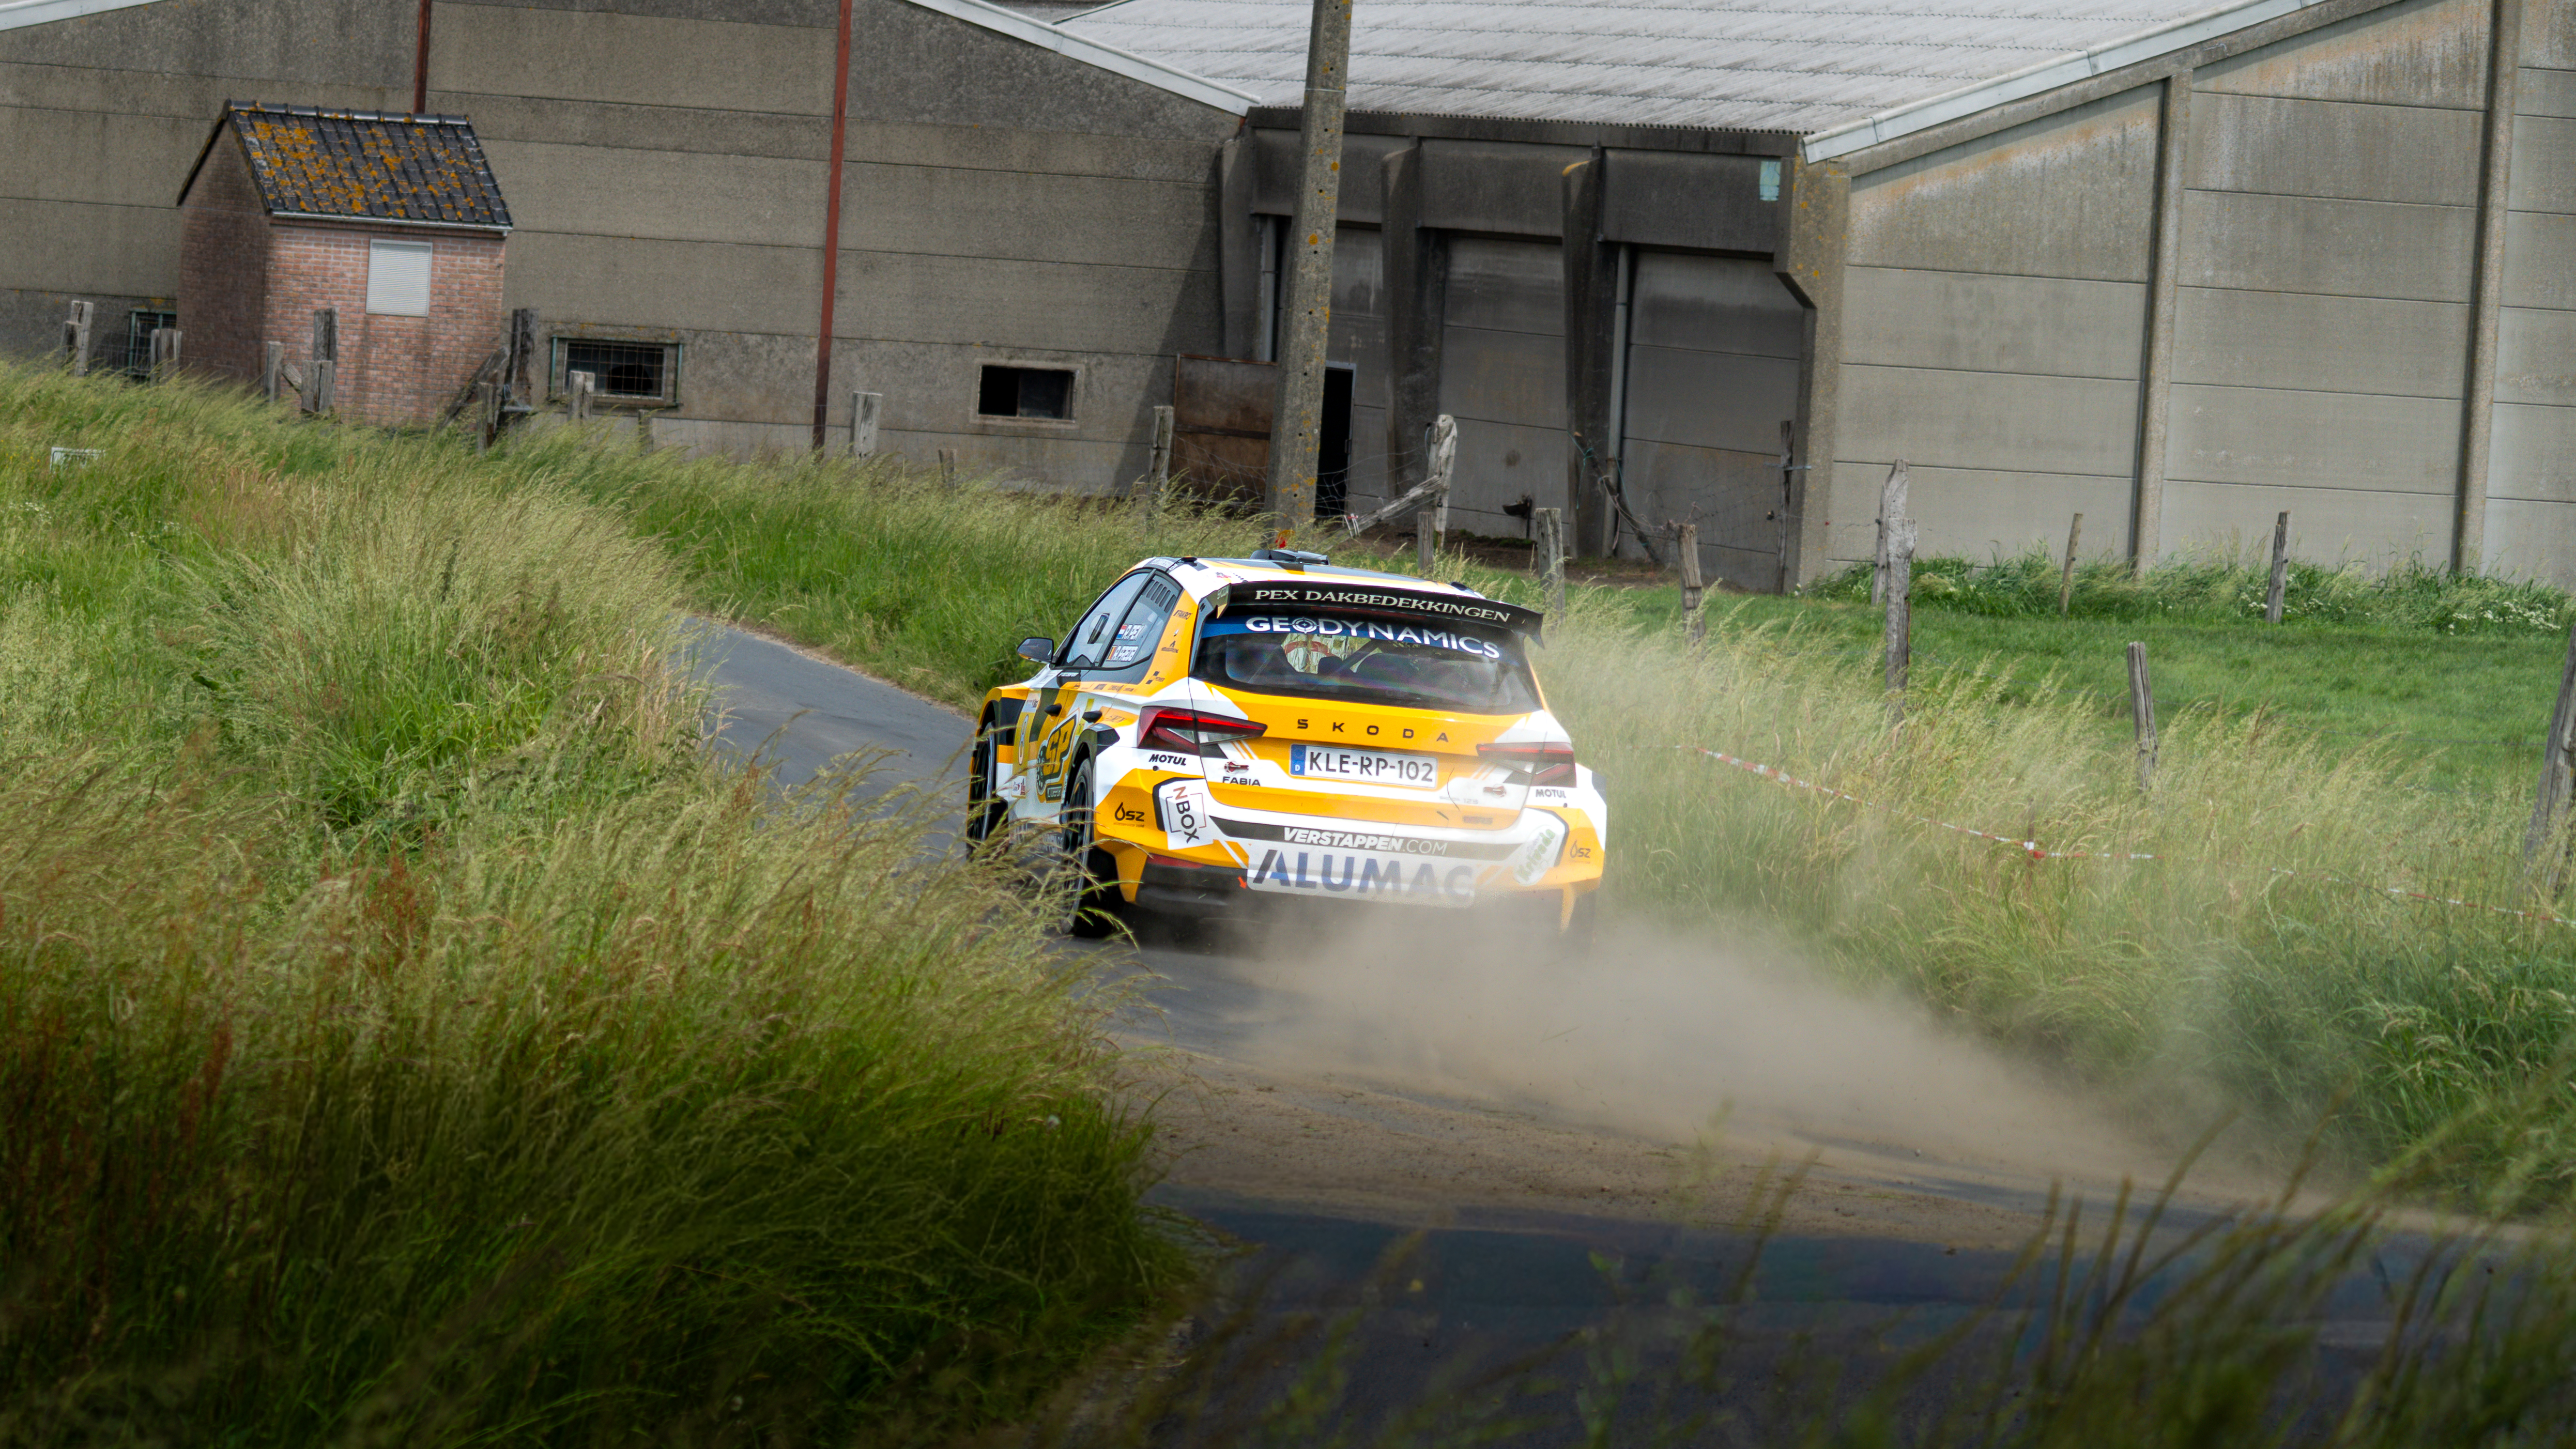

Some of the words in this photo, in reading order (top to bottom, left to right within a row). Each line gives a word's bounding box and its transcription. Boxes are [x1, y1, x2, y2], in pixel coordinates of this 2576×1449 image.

[1255, 590, 1298, 600] PEX
[1305, 591, 1511, 622] DAKBEDEKKINGEN
[1245, 616, 1500, 659] GEODYNAMICS
[1148, 754, 1187, 766] MOTUL
[1310, 751, 1433, 782] KLE-RP-102
[1222, 776, 1261, 787] FABIA
[1535, 789, 1567, 799] MOTUL
[1173, 786, 1200, 844] NBOX
[1283, 827, 1448, 856] VERSTAPPEN.COM
